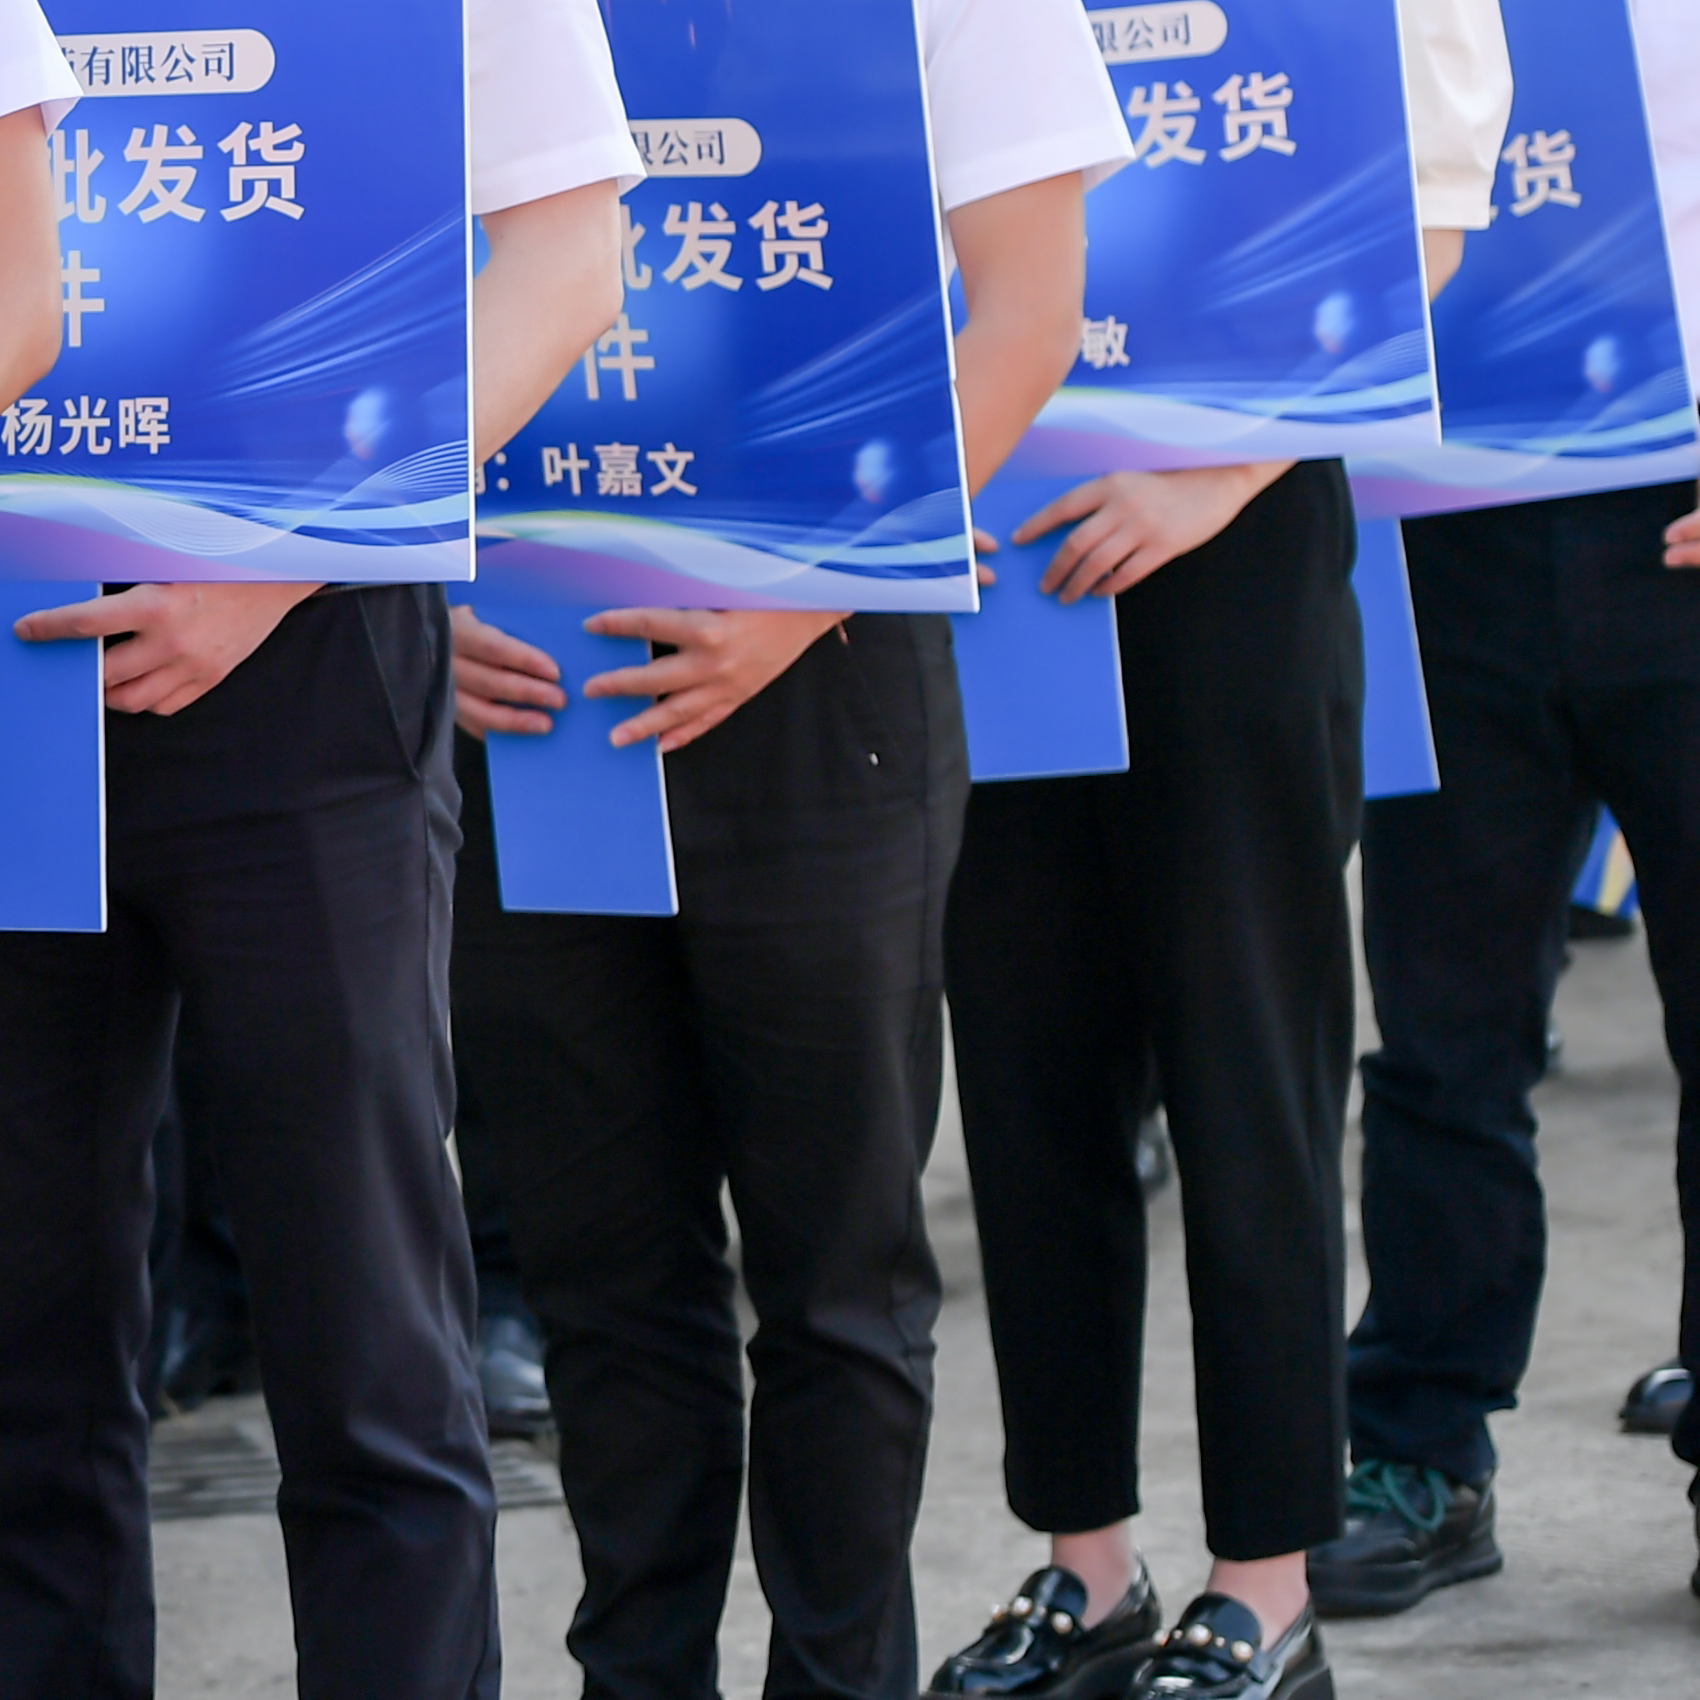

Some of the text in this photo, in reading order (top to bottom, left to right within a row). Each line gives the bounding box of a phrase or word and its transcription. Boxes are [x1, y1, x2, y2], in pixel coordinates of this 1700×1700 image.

[1490, 129, 1582, 221] 货
[0, 395, 171, 456] 杨光晖
